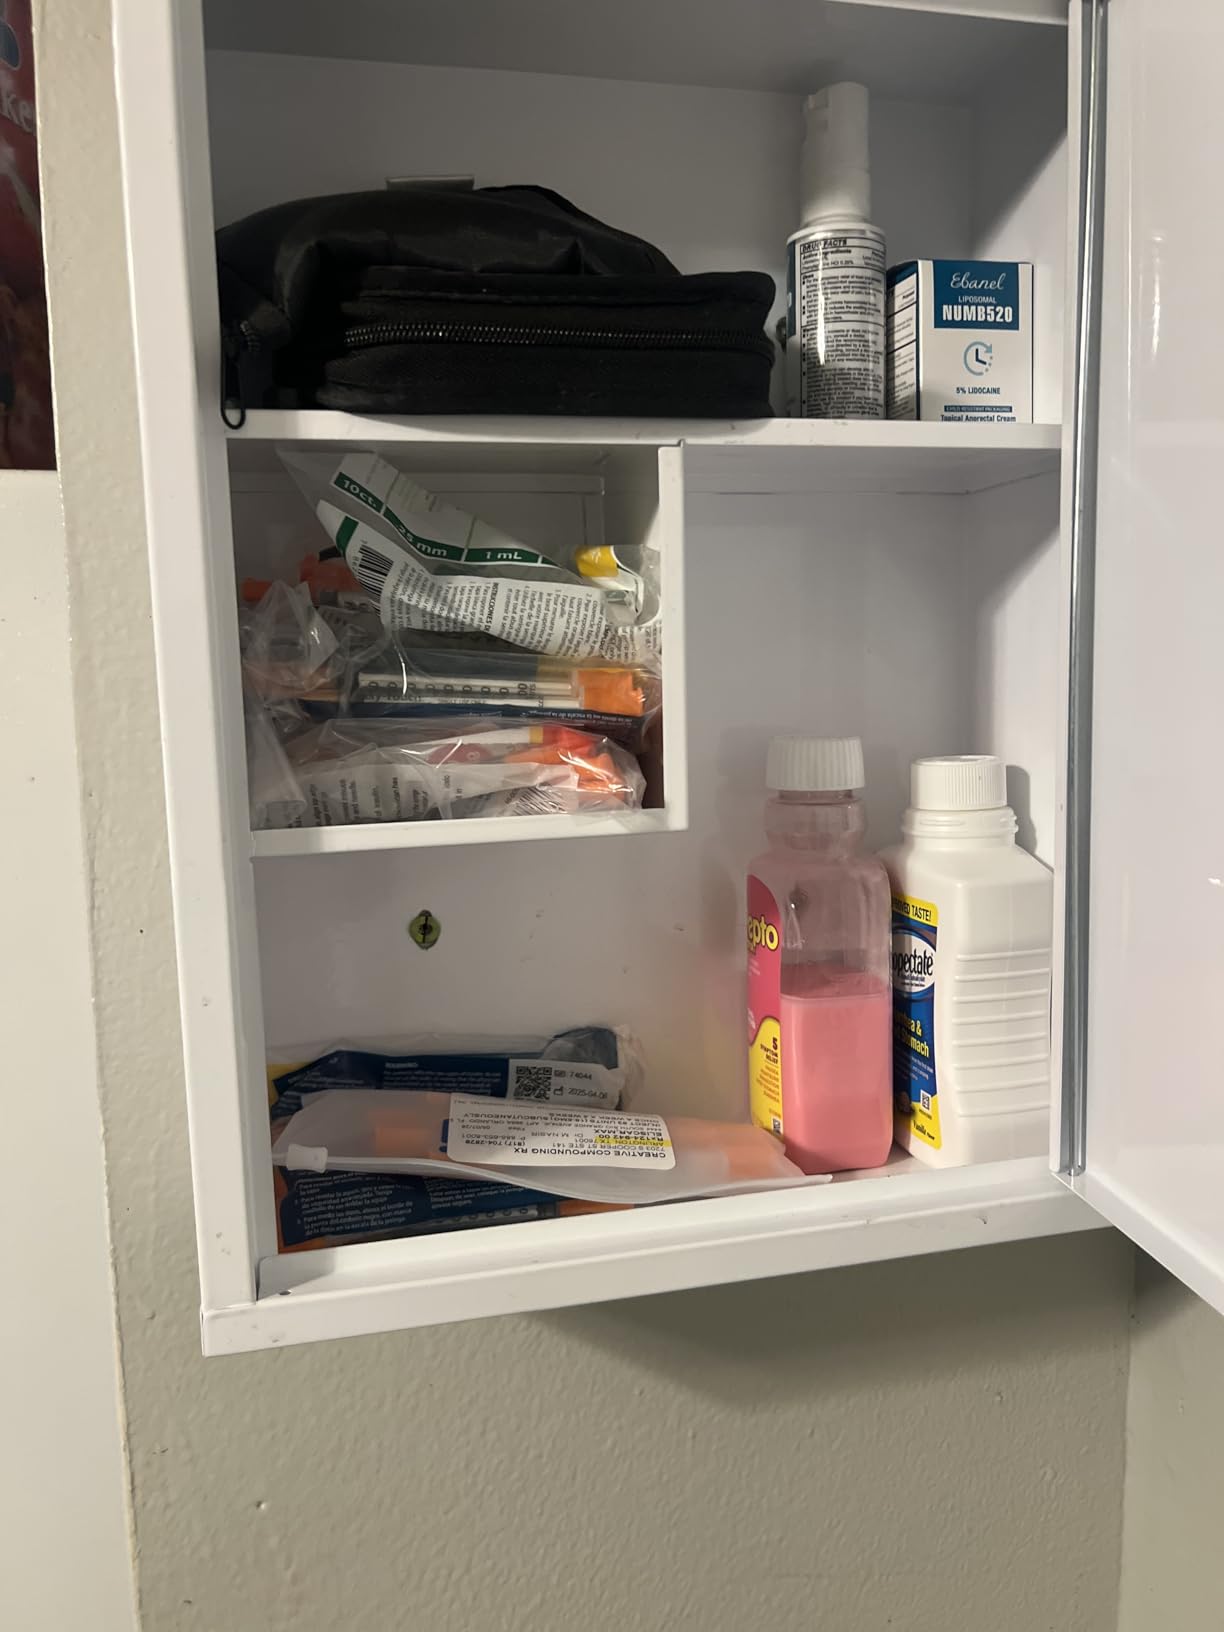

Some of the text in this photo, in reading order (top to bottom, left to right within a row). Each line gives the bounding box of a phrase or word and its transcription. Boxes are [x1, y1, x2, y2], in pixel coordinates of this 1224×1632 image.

[950, 272, 1006, 291] Ebanel
[958, 295, 996, 304] LIPOSOMAL
[942, 304, 1013, 323] NUMB520
[940, 414, 963, 422] Topical
[416, 541, 448, 557] mm
[497, 551, 523, 560] mL
[912, 905, 931, 922] TASTE!
[531, 1147, 611, 1157] COMPOUNDING
[614, 1150, 666, 1159] CREATIVE
